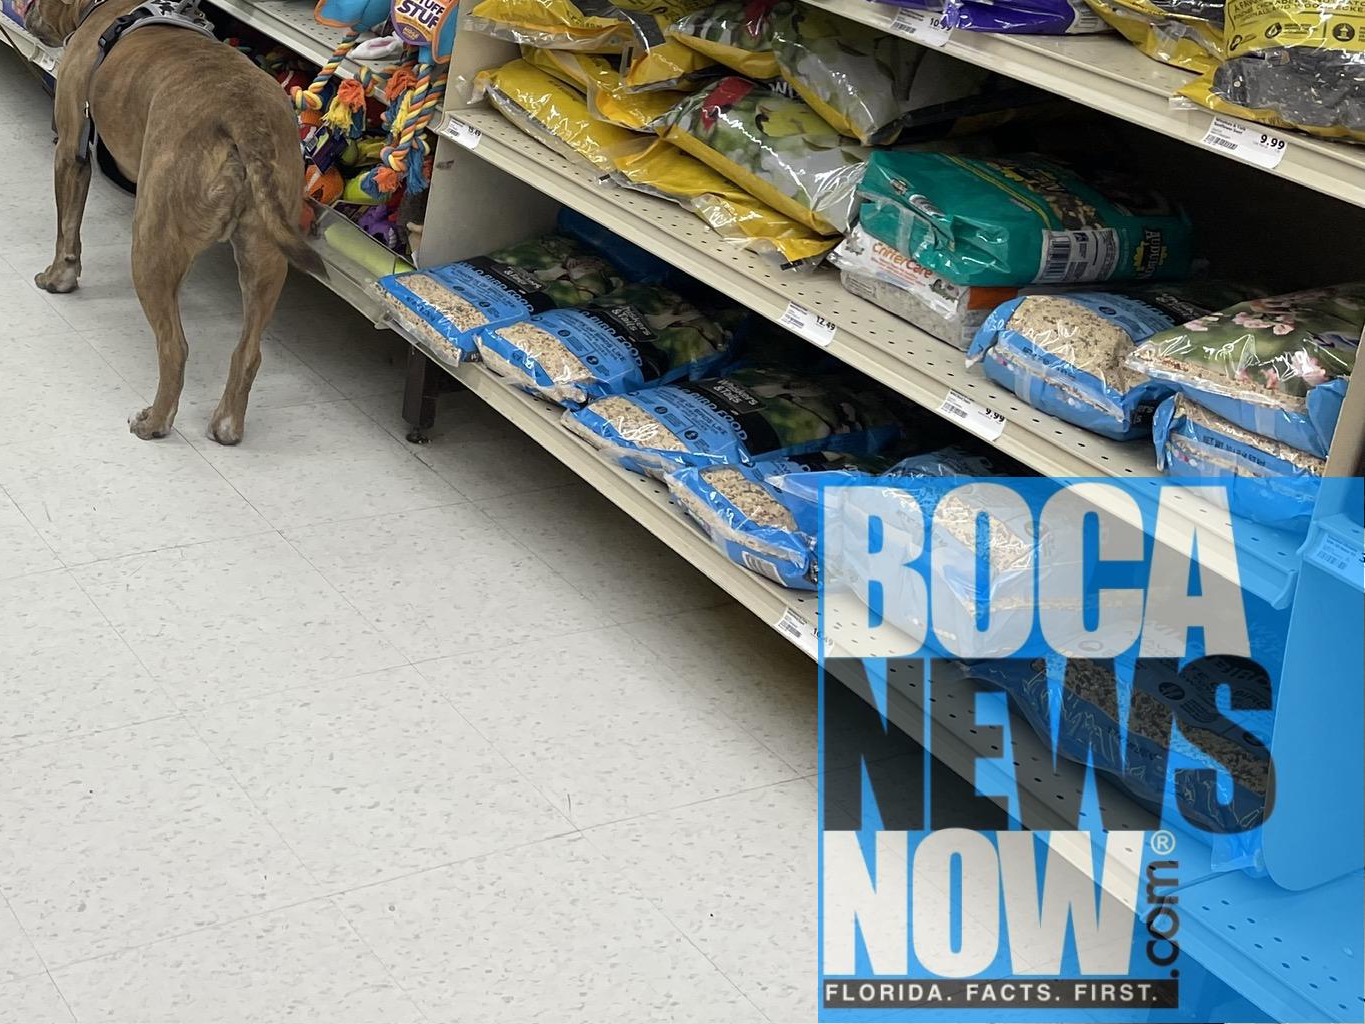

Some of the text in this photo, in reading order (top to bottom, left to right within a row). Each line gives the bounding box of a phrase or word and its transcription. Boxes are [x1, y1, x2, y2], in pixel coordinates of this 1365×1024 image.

[397, 0, 440, 29] STUF
[1260, 133, 1285, 150] 9.99
[871, 241, 934, 279] CritterCare
[506, 288, 535, 313] FOOD
[816, 315, 837, 332] 12.49
[615, 333, 644, 367] FOOD
[717, 409, 749, 443] FOOD
[985, 407, 1006, 423] 9.99
